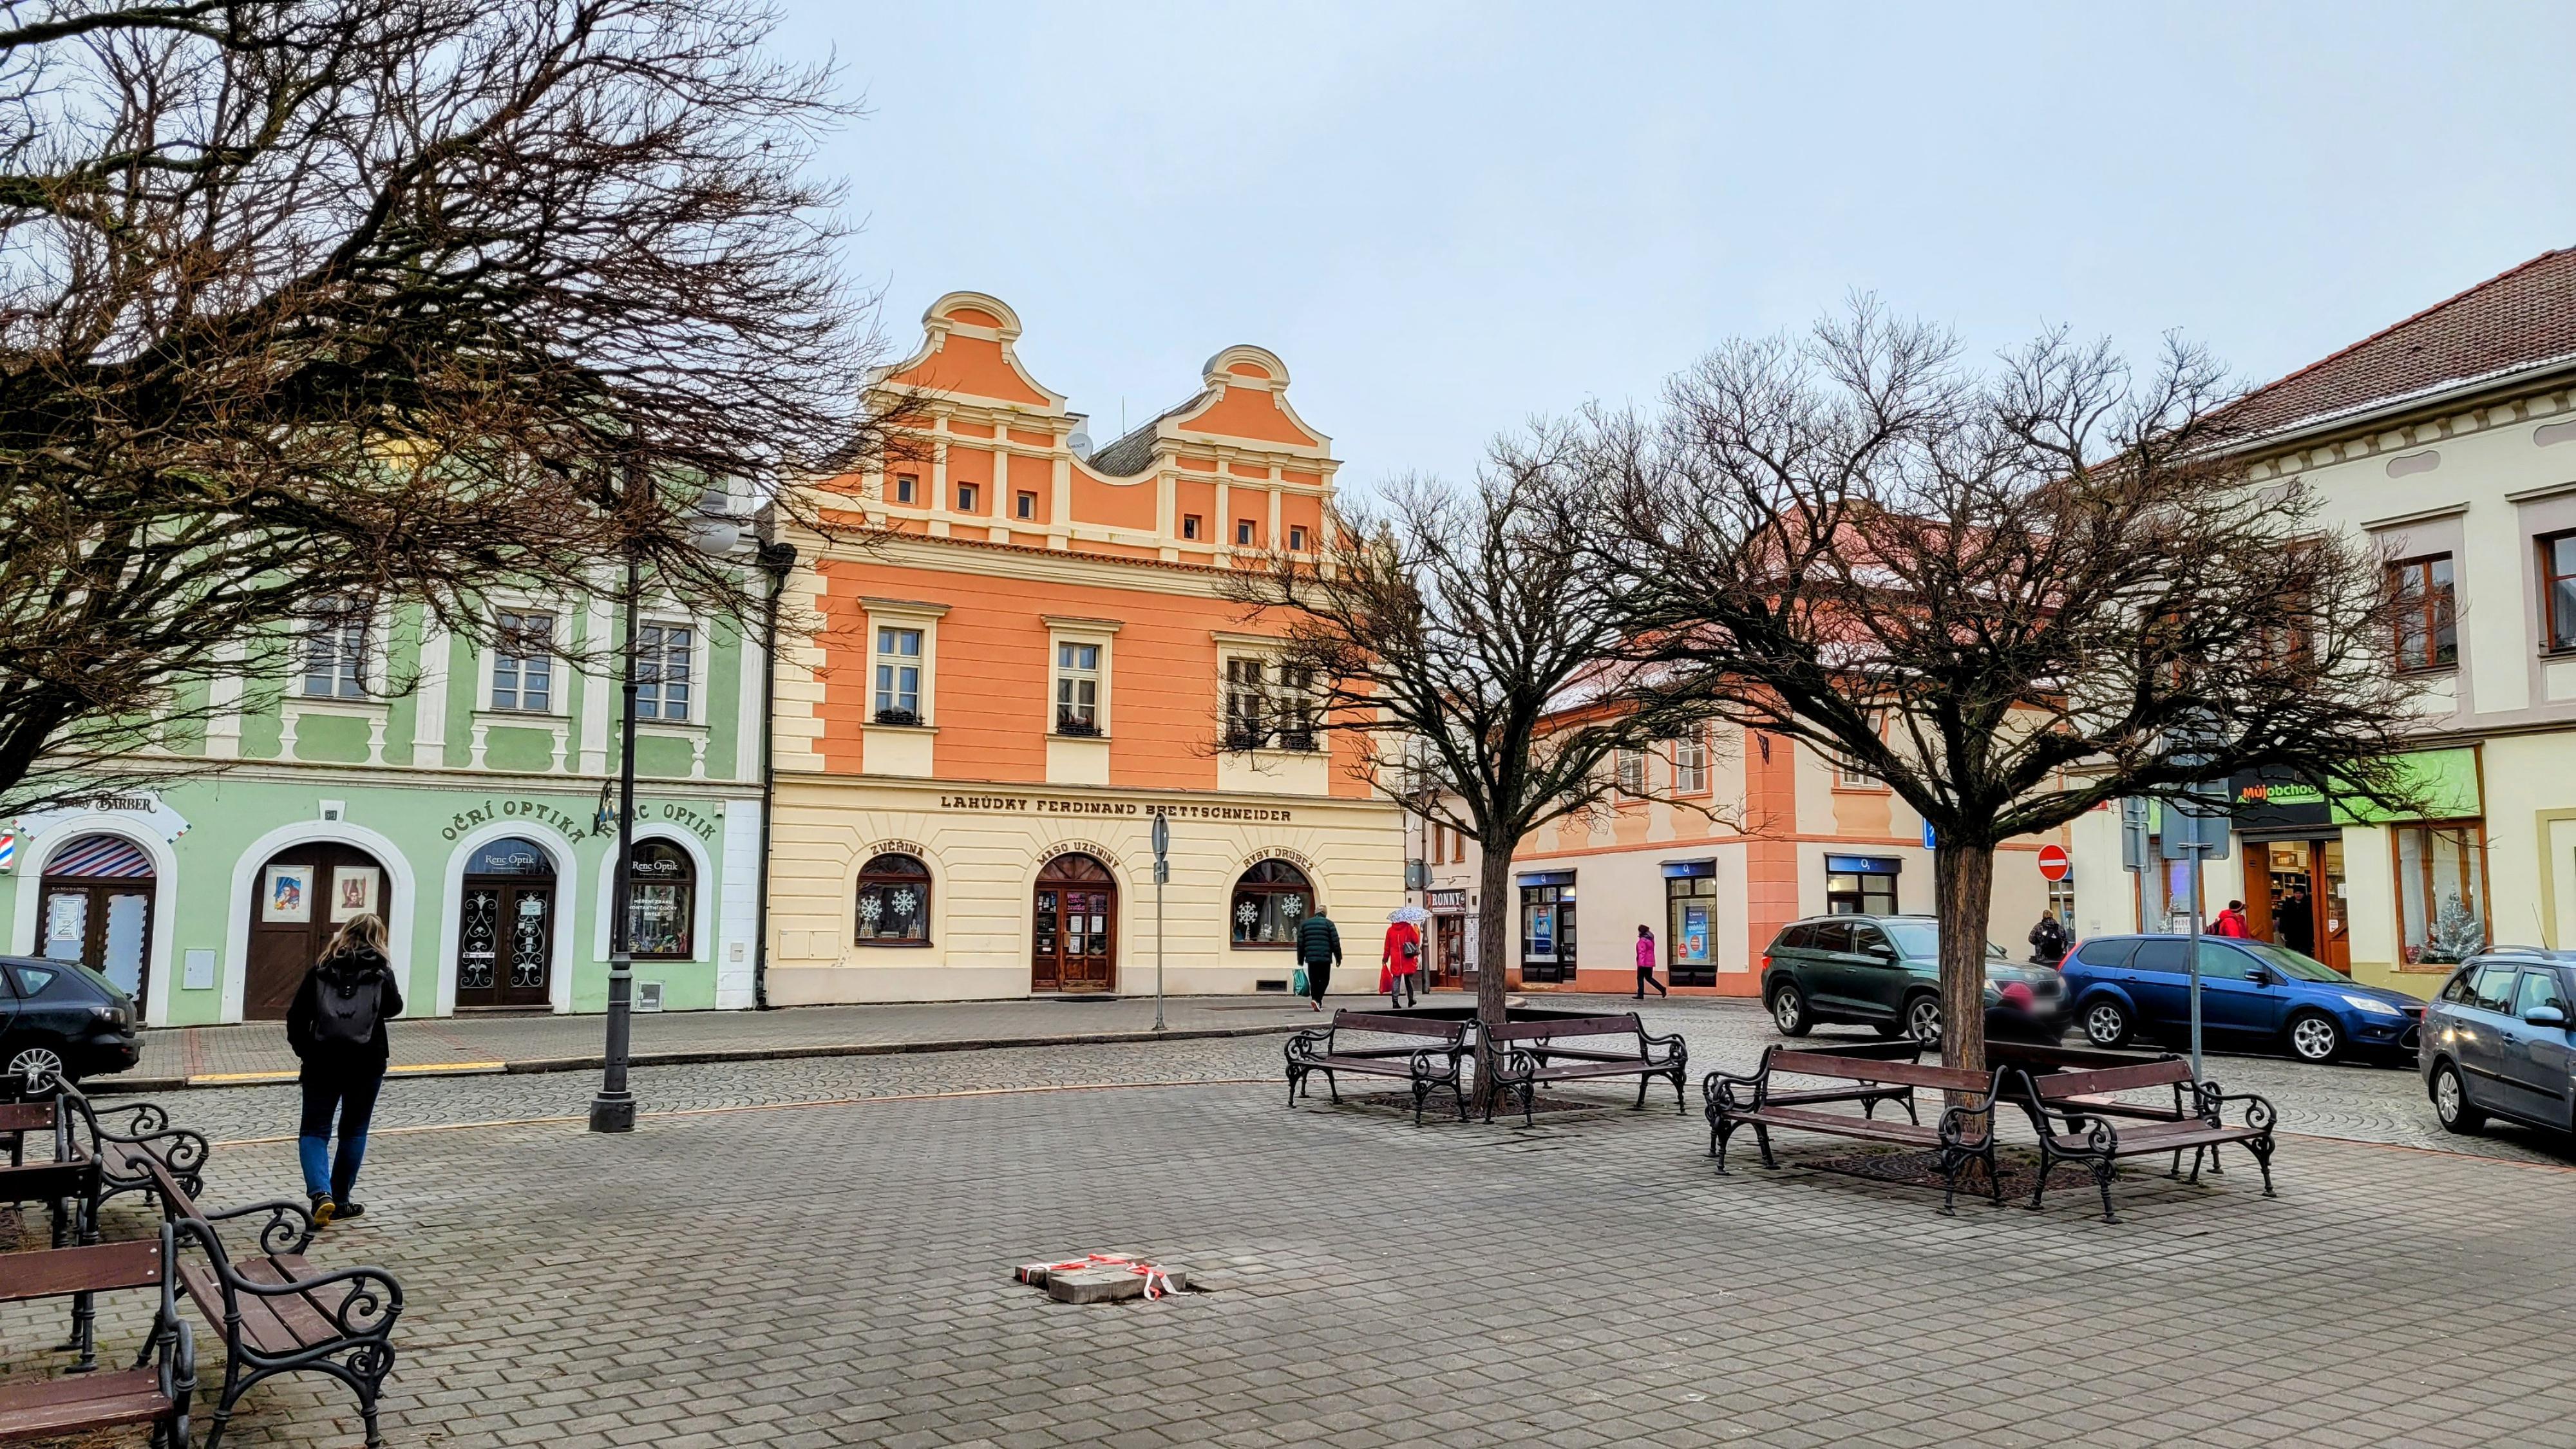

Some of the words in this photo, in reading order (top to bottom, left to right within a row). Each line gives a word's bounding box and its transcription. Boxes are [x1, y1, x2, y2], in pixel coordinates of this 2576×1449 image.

[940, 796, 1027, 811] LAHŮDKY
[1036, 800, 1137, 815] FERDINAND
[1145, 804, 1291, 821] BRETTSCHNEIDER
[503, 800, 585, 845] OPTIKA
[663, 804, 717, 841] OPTIK
[870, 840, 924, 858] ZVĚŘINA
[1036, 843, 1068, 866] MASO
[1074, 842, 1119, 869] UZENINY
[1243, 849, 1269, 868] RYBY
[485, 855, 509, 866] Renc
[508, 852, 534, 866] Optik
[632, 861, 654, 872] Renc
[654, 859, 678, 873] Optik
[1432, 893, 1461, 906] RONNY
